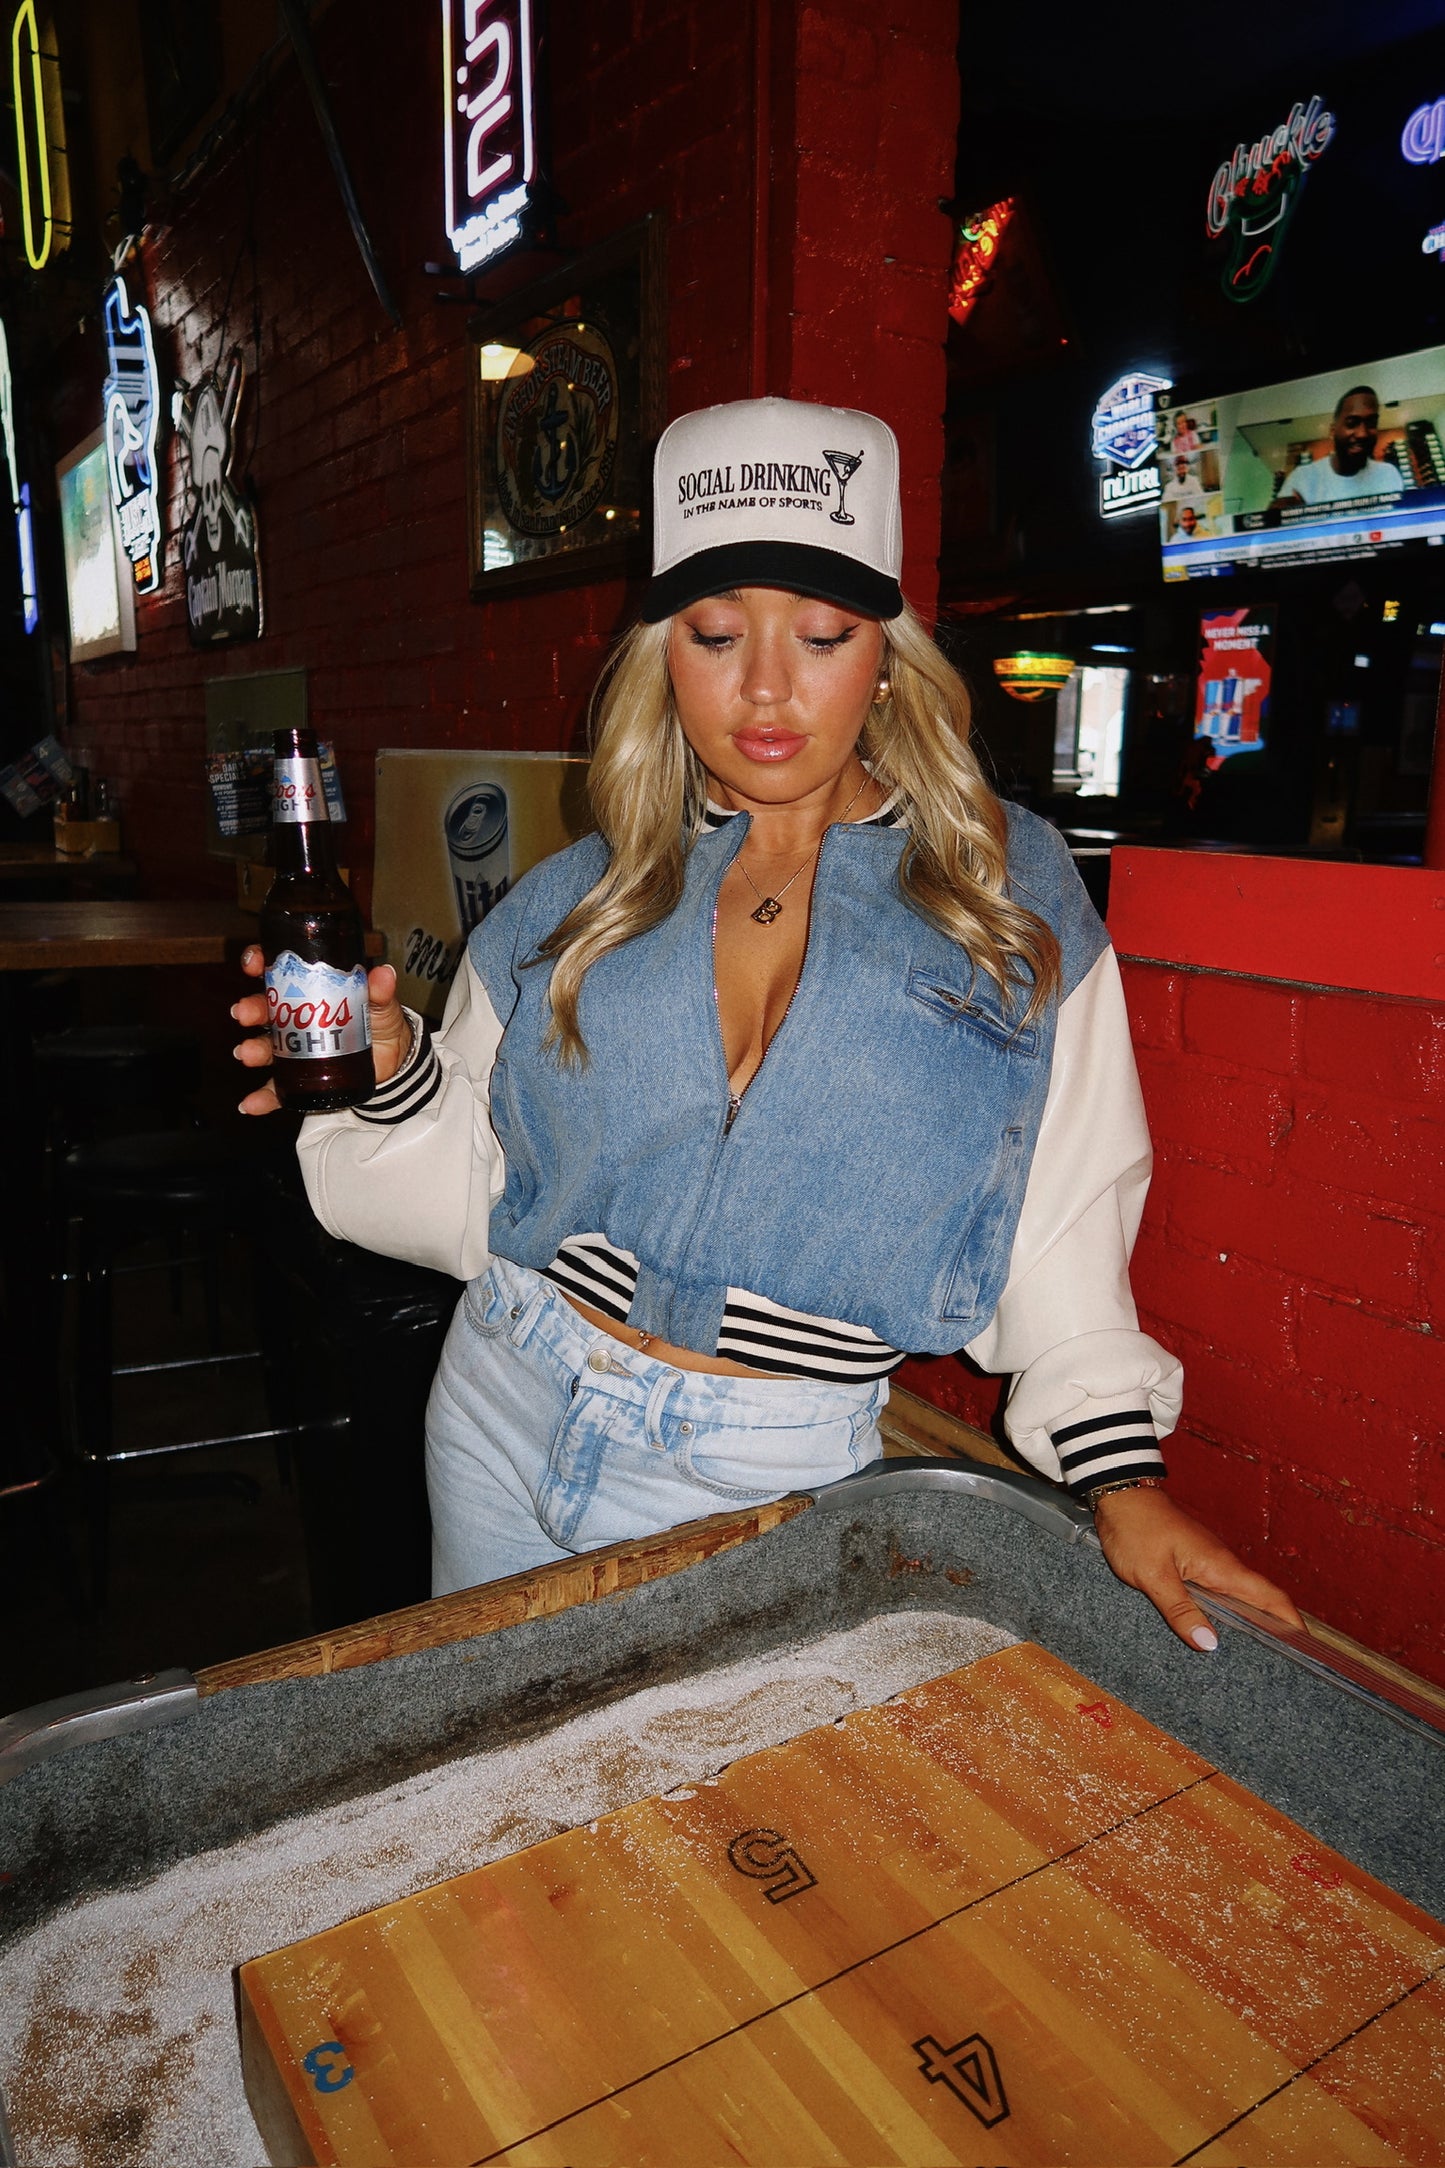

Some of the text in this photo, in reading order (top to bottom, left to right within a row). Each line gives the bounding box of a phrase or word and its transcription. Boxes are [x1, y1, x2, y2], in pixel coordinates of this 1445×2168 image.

[1206, 95, 1336, 238] Chuckle
[504, 343, 613, 442] ANCHOR STEAM BEER
[678, 463, 831, 505] SOCIAL DRINKING
[683, 497, 823, 519] IN THE NAME OF SPORTS
[187, 565, 219, 630] Captain
[215, 560, 254, 622] Morgan
[1204, 624, 1270, 639] NEVER MISS A
[1213, 637, 1259, 650] MOMENT
[266, 986, 353, 1030] Coors
[727, 1828, 819, 1905] 5
[303, 2041, 355, 2093] 3
[912, 2032, 1010, 2130] 4
